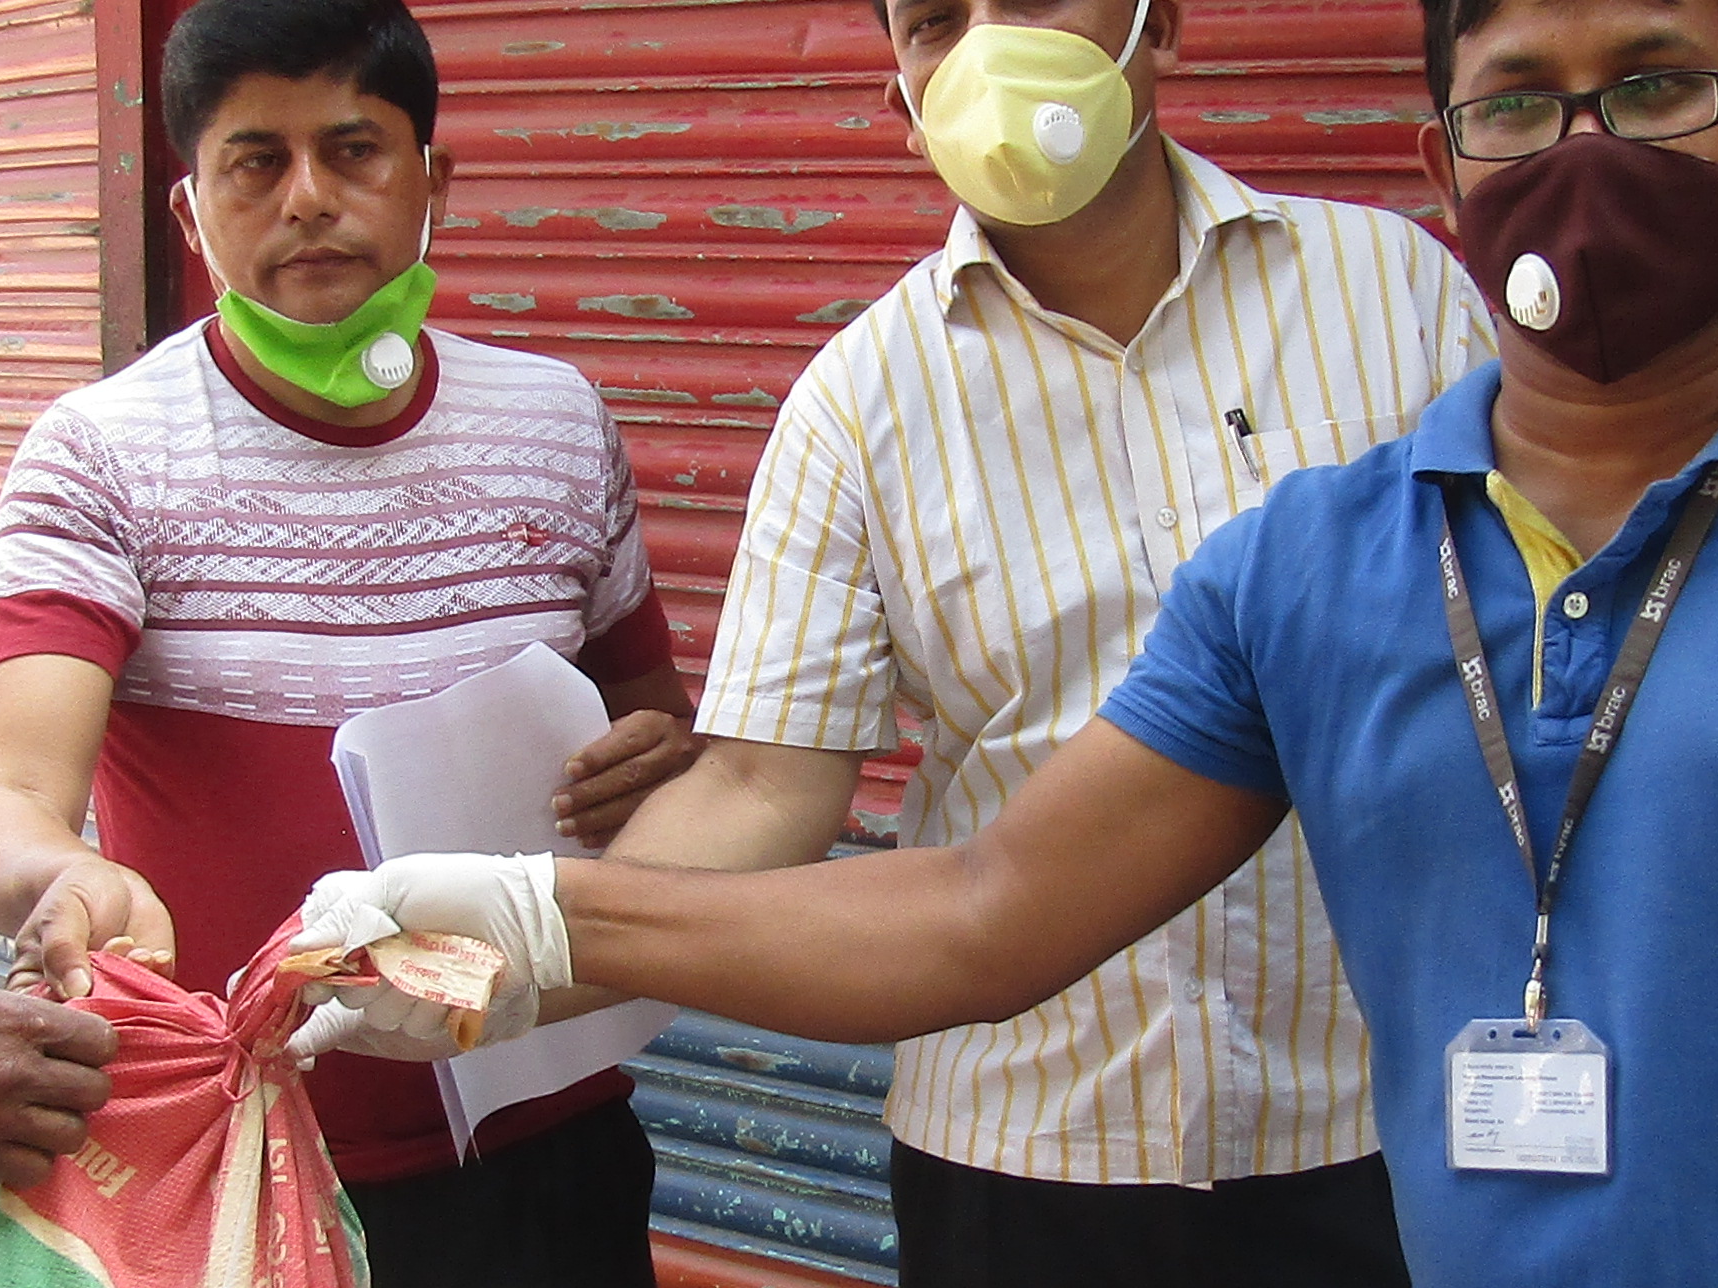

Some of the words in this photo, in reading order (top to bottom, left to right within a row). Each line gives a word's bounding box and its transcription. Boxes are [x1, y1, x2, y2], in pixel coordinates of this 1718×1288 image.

[1443, 559, 1459, 600] brac
[1650, 558, 1681, 603] brac
[1470, 677, 1490, 721] brac
[1599, 685, 1627, 731] brac
[1506, 804, 1526, 848] brac
